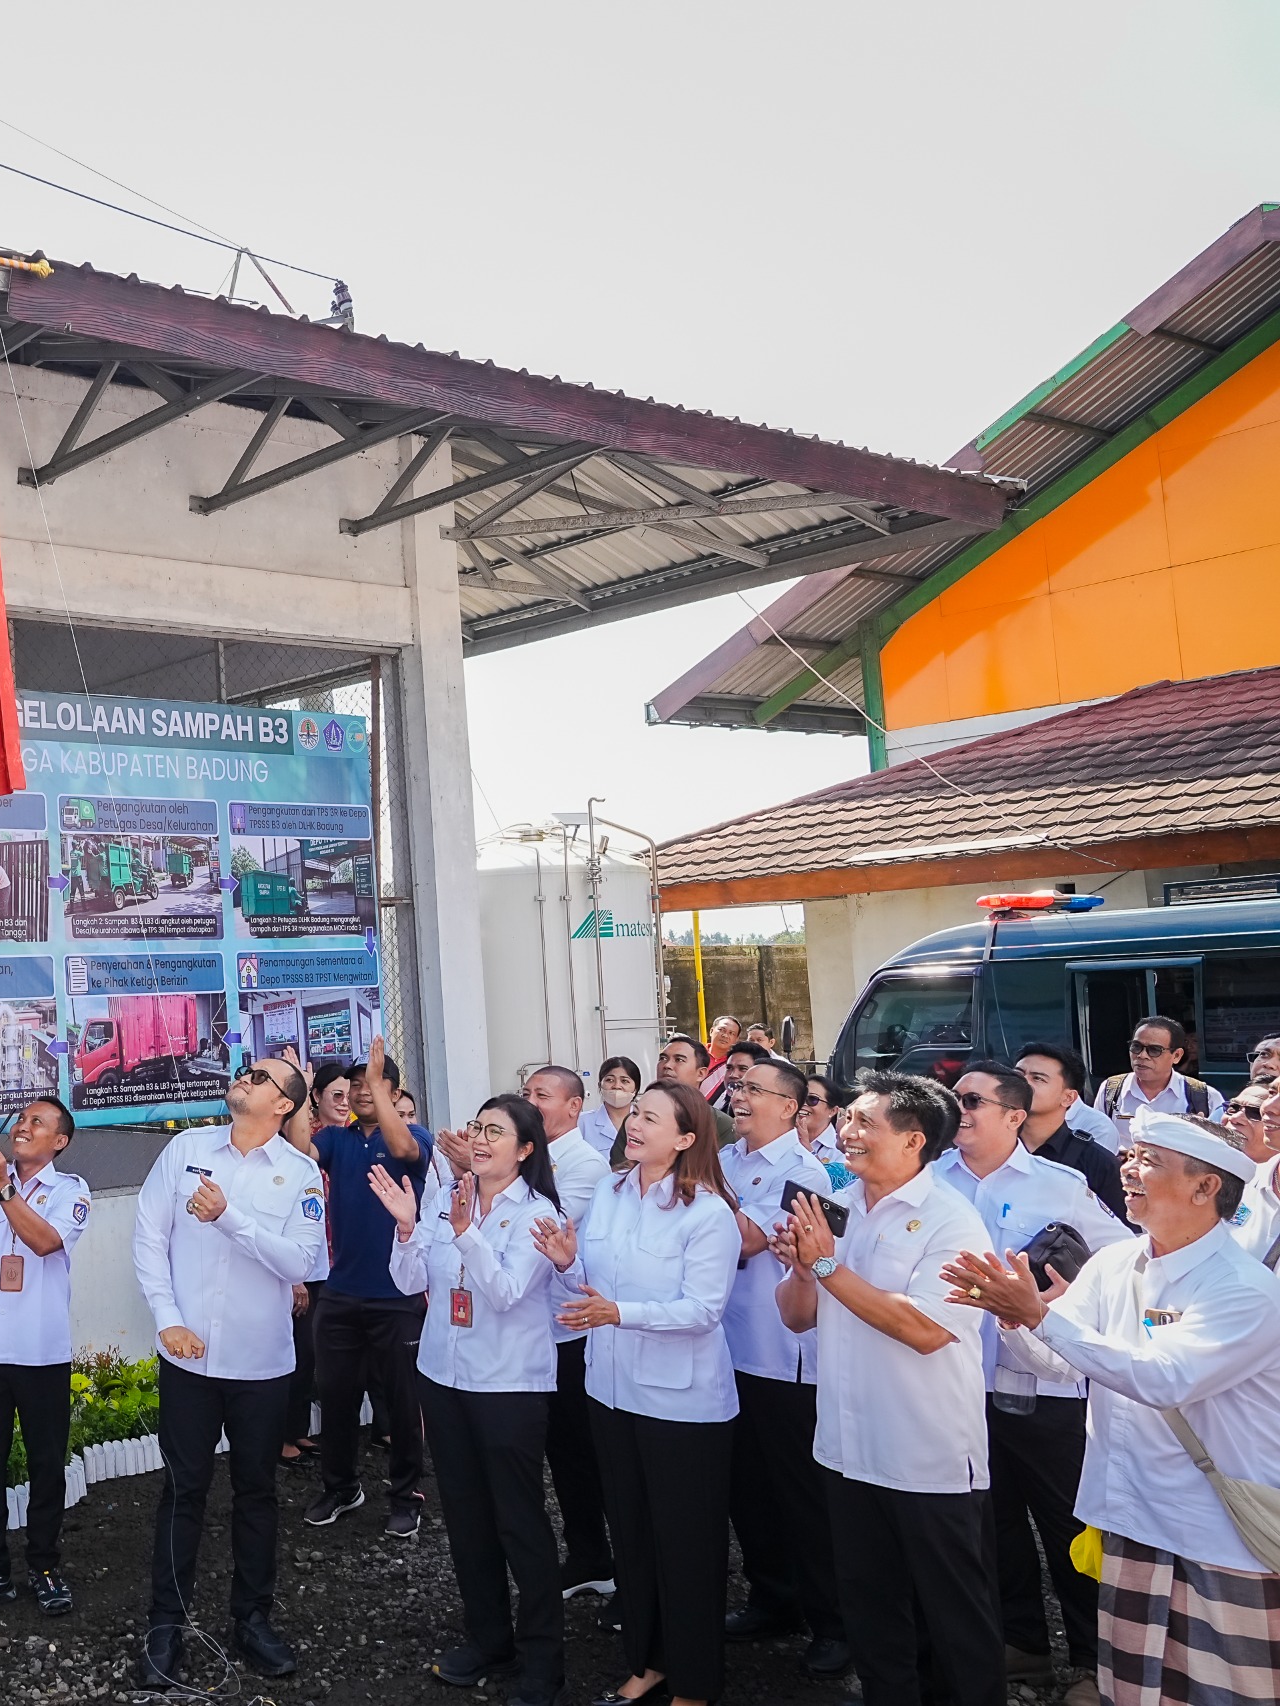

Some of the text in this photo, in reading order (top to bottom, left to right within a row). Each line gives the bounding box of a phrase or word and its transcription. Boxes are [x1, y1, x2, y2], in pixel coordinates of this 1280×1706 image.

[152, 708, 253, 742] SAMPAH
[258, 716, 289, 744] B3
[61, 750, 180, 779] KABUPATEN
[186, 756, 269, 783] BADUNG
[97, 800, 189, 816] Pengangkutan oleh
[248, 805, 367, 819] Pengangkutan dari TPS 3R ke Depo
[98, 816, 214, 832] Petugas Desa/Kelurahan
[249, 819, 344, 833] TPSSS B3 oleh DLHK Badung
[4, 918, 14, 927] B3
[14, 918, 28, 927] dan
[72, 917, 98, 928] Langkah
[104, 917, 129, 927] Sampah
[130, 917, 138, 925] B3
[144, 917, 154, 925] LB3
[154, 917, 160, 925] di
[160, 917, 180, 926] angkut
[180, 917, 193, 925] oleh
[193, 917, 216, 926] petugas
[250, 916, 272, 925] Langkah
[277, 916, 298, 925] Petugas
[310, 916, 330, 925] Badung
[330, 916, 361, 925] mengangkut
[0, 928, 27, 938] Tangga
[75, 927, 120, 935] Desa/Kelurahan
[120, 926, 140, 934] dibawa
[250, 925, 272, 934] sampah
[298, 925, 333, 934] menggunakan
[90, 958, 217, 973] Penyerahan & Pengangkutan
[259, 957, 315, 969] Penampungan
[316, 956, 356, 966] Sementara
[91, 974, 188, 989] ke Pihak Ketiga Berizin
[260, 971, 374, 986] Depo TPSSS B3 TPST Mengwitani
[23, 1089, 48, 1099] Sampah
[86, 1086, 113, 1096] Langkah
[119, 1084, 145, 1093] Sampah
[145, 1083, 154, 1091] B3
[160, 1081, 170, 1090] LB3
[170, 1081, 186, 1090] yang
[186, 1080, 220, 1088] tertampung
[82, 1087, 227, 1106] di Depo TPSSS B3 diserahkan ke pihak ketiga berizin
[3, 1103, 24, 1112] proses
